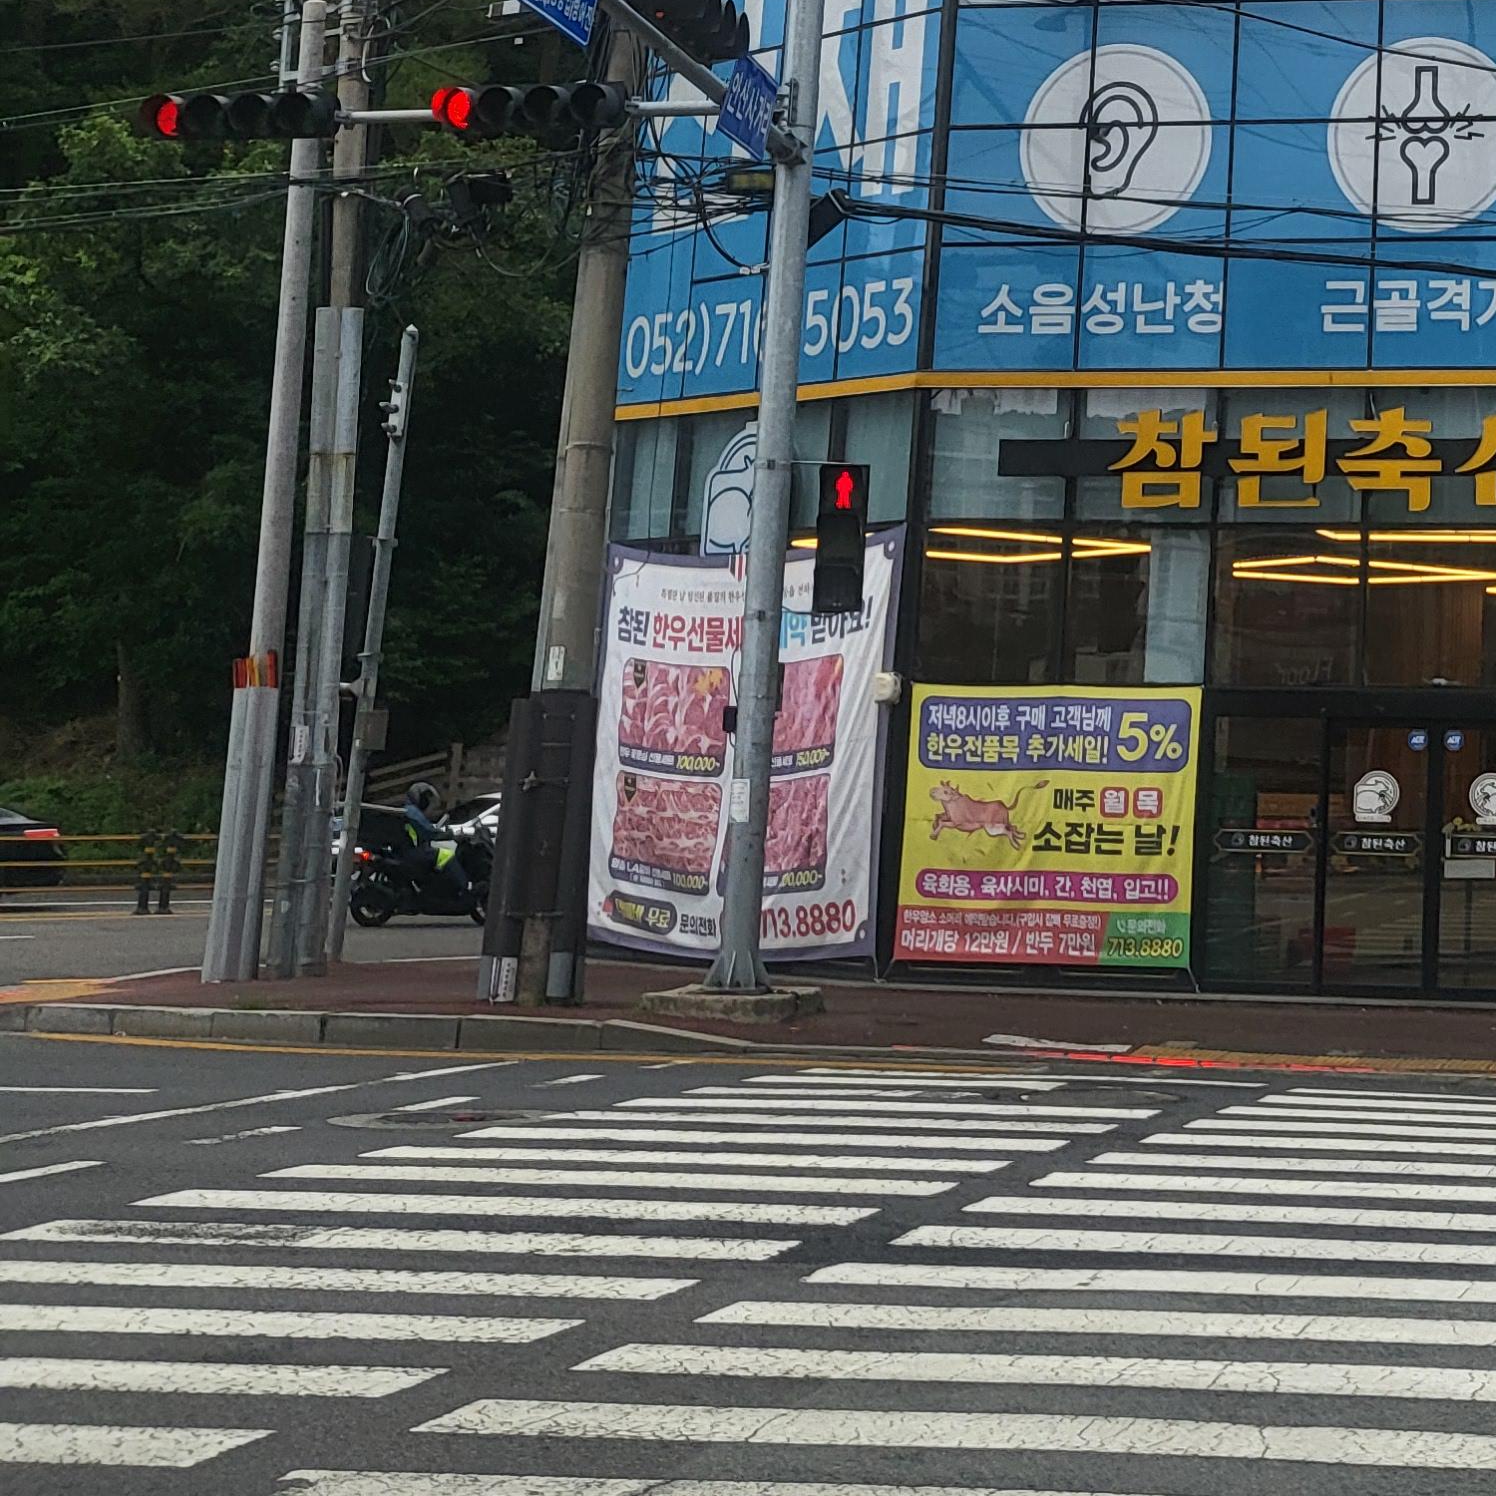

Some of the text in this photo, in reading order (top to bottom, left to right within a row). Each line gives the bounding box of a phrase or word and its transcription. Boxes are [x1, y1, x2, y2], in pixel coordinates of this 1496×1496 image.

[977, 280, 1225, 336] 소음성난청
[626, 277, 914, 379] 052)715053
[617, 605, 650, 647] 참된
[652, 612, 745, 653] 한우선물세
[928, 704, 1112, 732] 저녁8시이후 구매 고객님께
[927, 732, 1109, 764] 한우전품목 추가세일!
[1117, 712, 1183, 762] 5%
[1053, 788, 1159, 815] 매주 월 목
[1032, 822, 1181, 856] 소잡는 날!
[1248, 834, 1293, 847] 참된축산
[1361, 837, 1406, 850] 참된축산
[922, 873, 1169, 900] 육회용, 육사시미, 간, 천엽, 입고!!
[646, 907, 671, 929] 무료
[679, 913, 718, 938] 문의전화
[901, 928, 960, 953] 머리개당
[964, 930, 1009, 954] 12만원
[1025, 930, 1054, 955] 반두
[1058, 932, 1096, 956] 7만원
[1107, 937, 1183, 958] 713.8880
